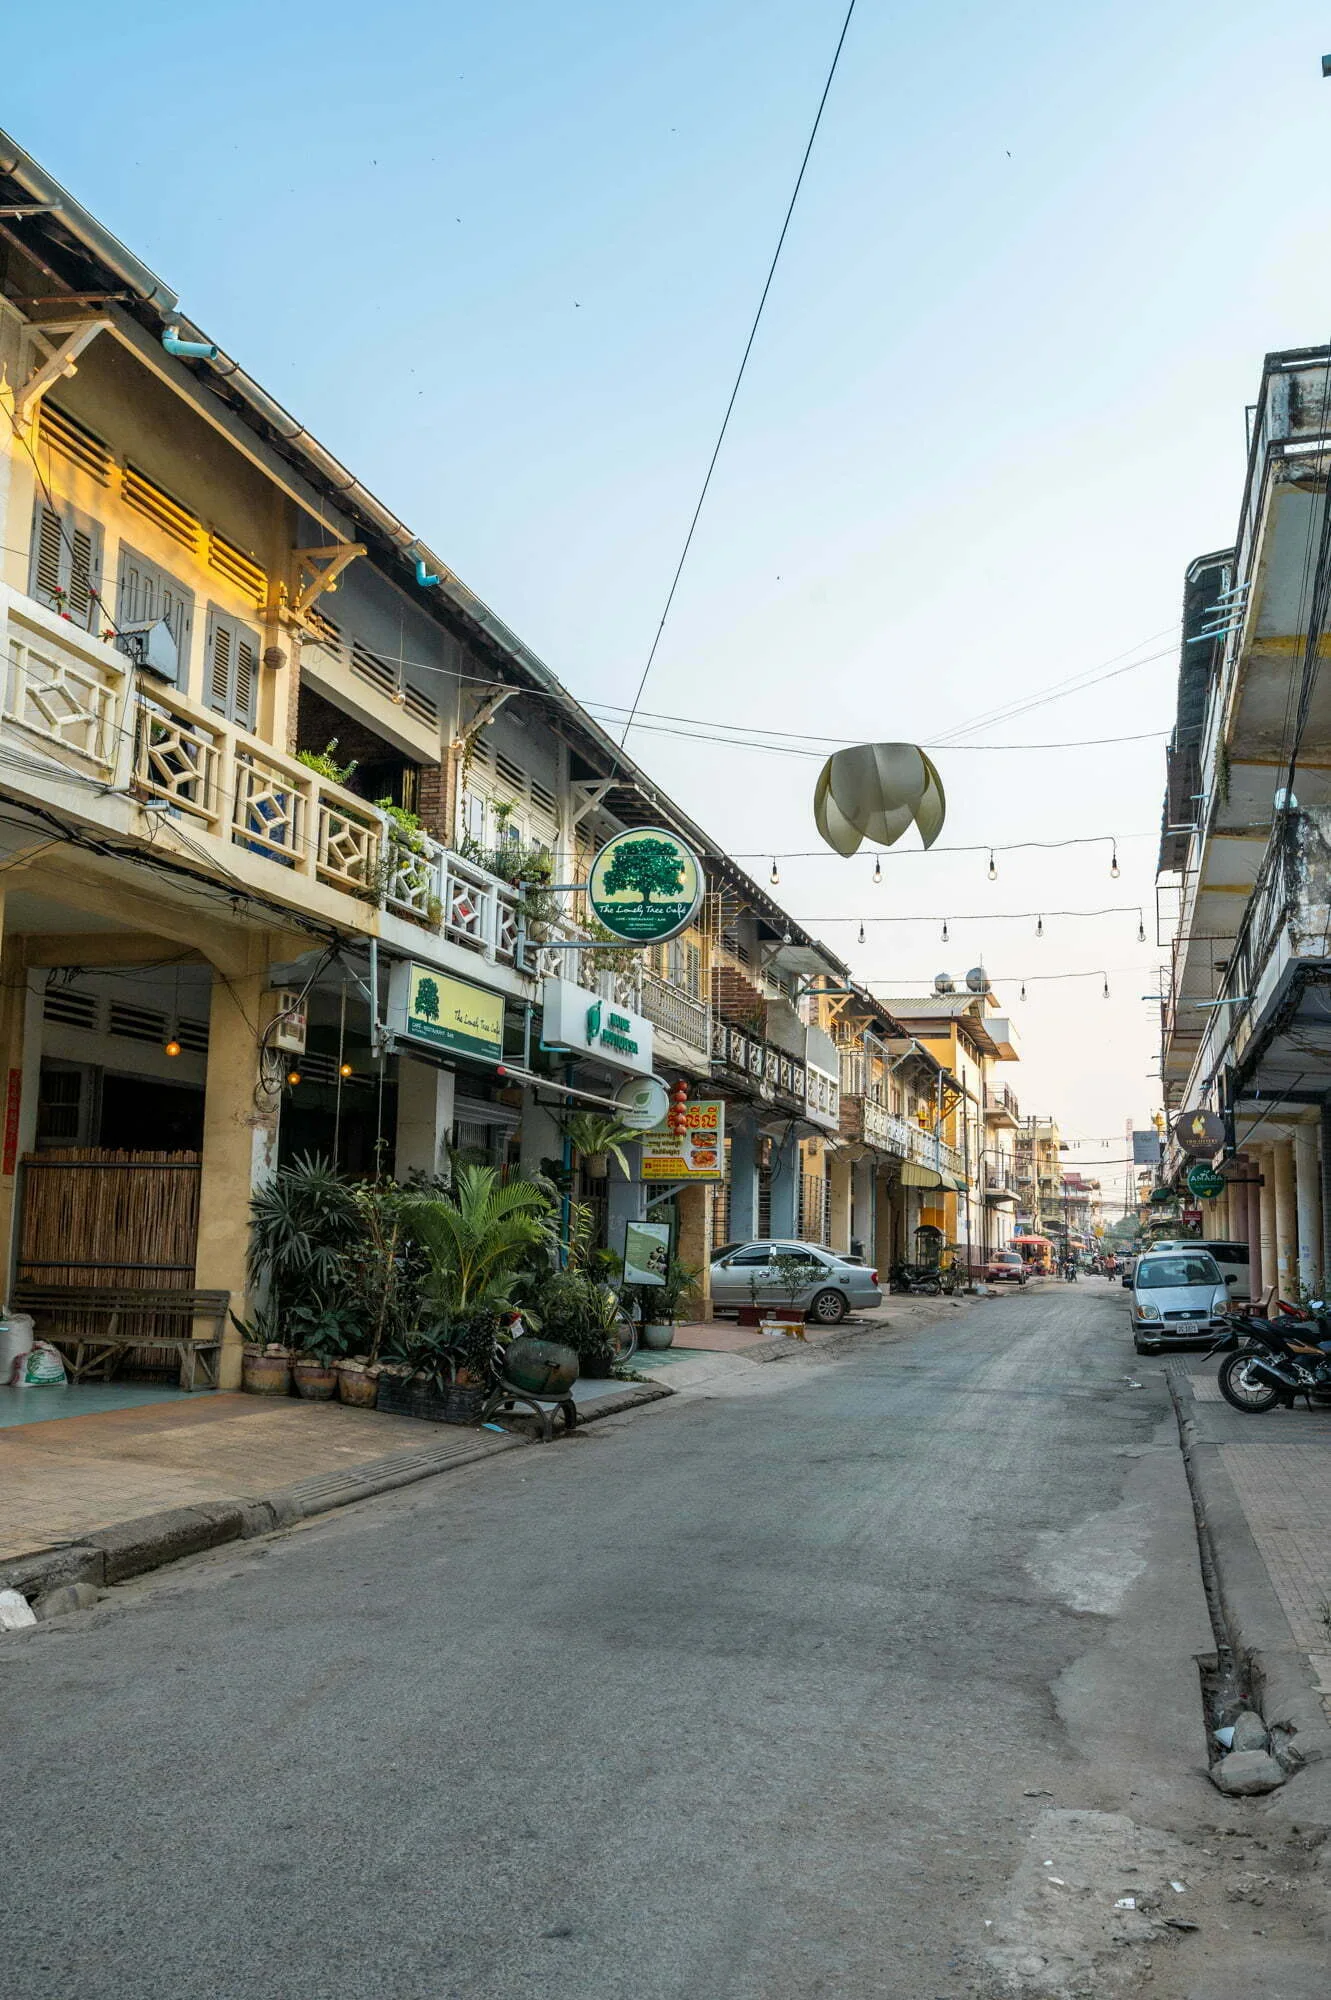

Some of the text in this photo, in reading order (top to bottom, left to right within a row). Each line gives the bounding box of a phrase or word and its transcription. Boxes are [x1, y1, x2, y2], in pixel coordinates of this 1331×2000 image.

[599, 904, 614, 914] The
[615, 904, 644, 917] Lonely
[646, 905, 664, 914] Tree
[454, 1008, 463, 1022] The
